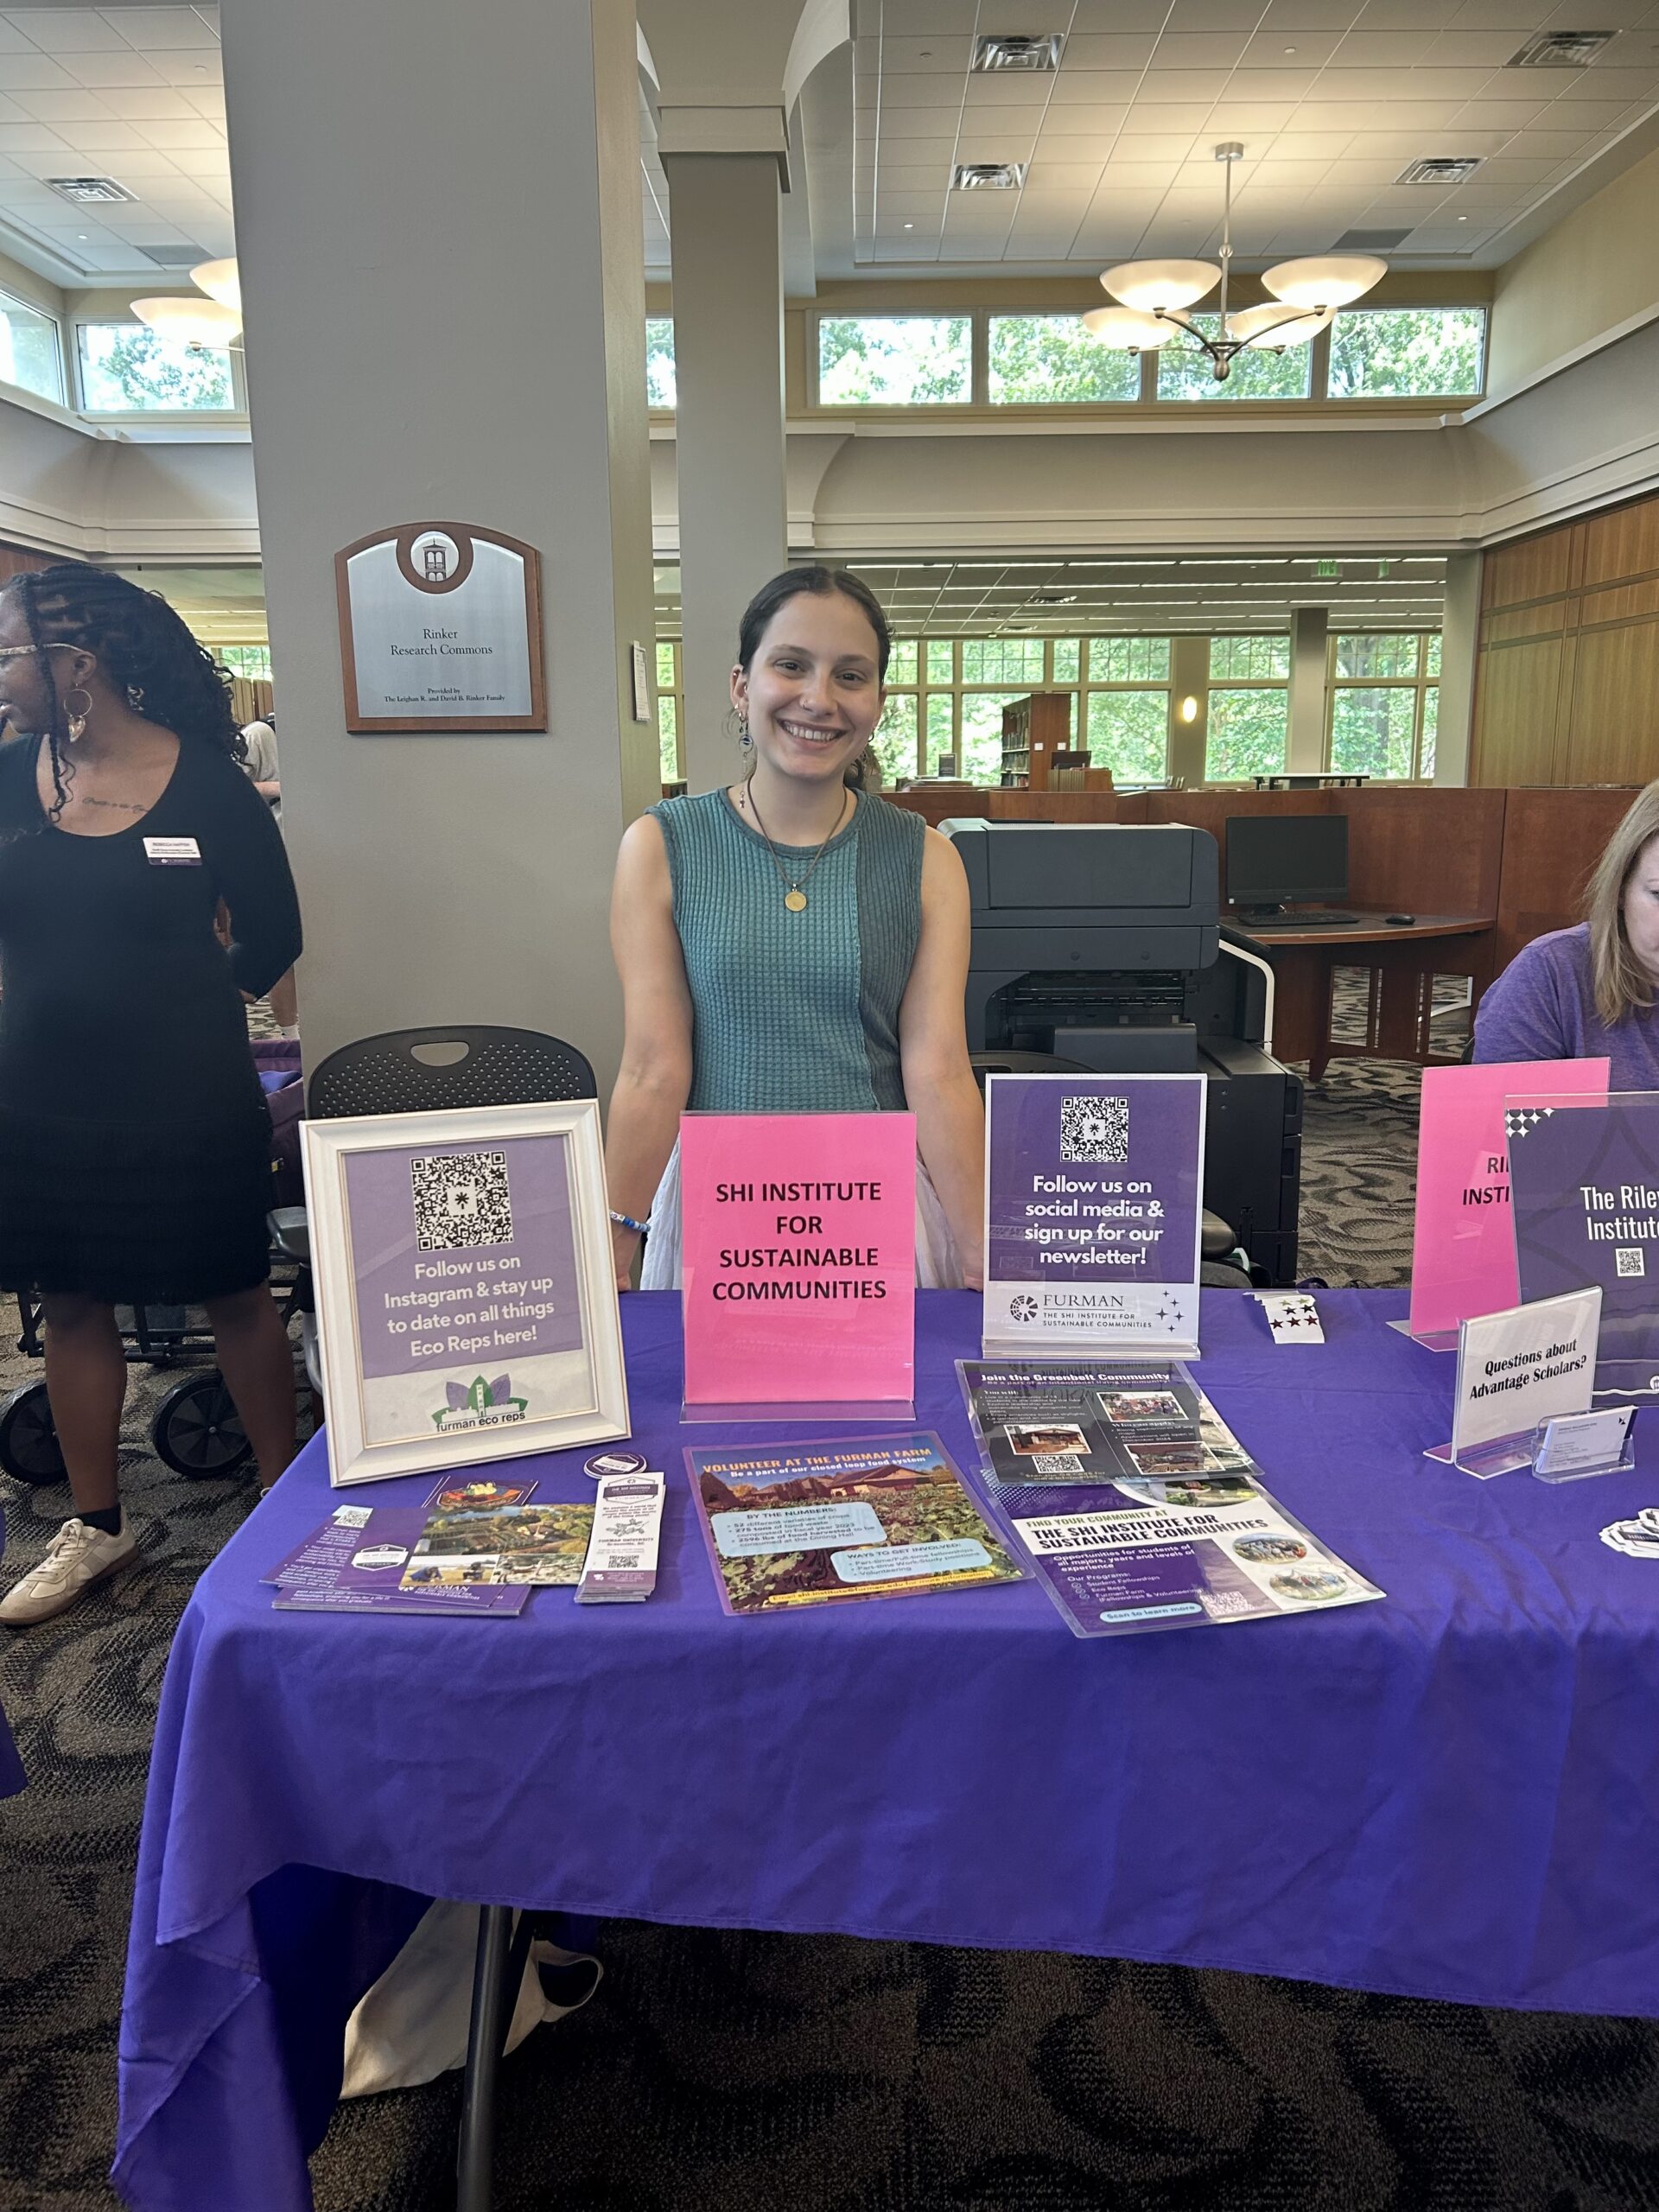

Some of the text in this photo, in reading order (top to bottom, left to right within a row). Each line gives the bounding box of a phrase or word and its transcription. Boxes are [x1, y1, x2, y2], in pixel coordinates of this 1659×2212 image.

[423, 628, 458, 639] Rinker
[391, 644, 493, 655] Research Commons
[715, 1182, 881, 1202] SHI INSTITUTE
[1033, 1175, 1152, 1193] Follow us on
[1580, 1185, 1659, 1210] The Rile
[1025, 1199, 1165, 1217] social media &
[777, 1217, 823, 1234] FOR
[1024, 1224, 1163, 1244] sign up for our
[1586, 1217, 1659, 1240] Institut
[719, 1248, 879, 1268] SUSTAINABLE
[1040, 1248, 1147, 1265] newsletter!
[415, 1256, 521, 1281] Follow us on
[385, 1277, 553, 1308] Instagram & stay up
[712, 1281, 887, 1300] COMMUNITIES
[1044, 1294, 1124, 1306] FURMAN
[387, 1300, 555, 1334] to date on all things
[410, 1325, 537, 1357] Eco Reps here!
[1484, 1338, 1577, 1376] Questions about
[1470, 1355, 1586, 1399] Advantage Scholars?
[436, 1412, 525, 1433] furman eco reps
[703, 1460, 781, 1472] VOLUNTEER
[804, 1457, 831, 1465] THE
[835, 1452, 892, 1462] FURMAN
[893, 1448, 931, 1457] FARM
[1032, 1514, 1220, 1539] THE SHI INSTITUTE FOR
[1087, 1512, 1152, 1522] COMMUNITY
[1039, 1519, 1268, 1548] SUSTAINABLE COMMUNITIES
[1053, 1551, 1120, 1560] Opportunities
